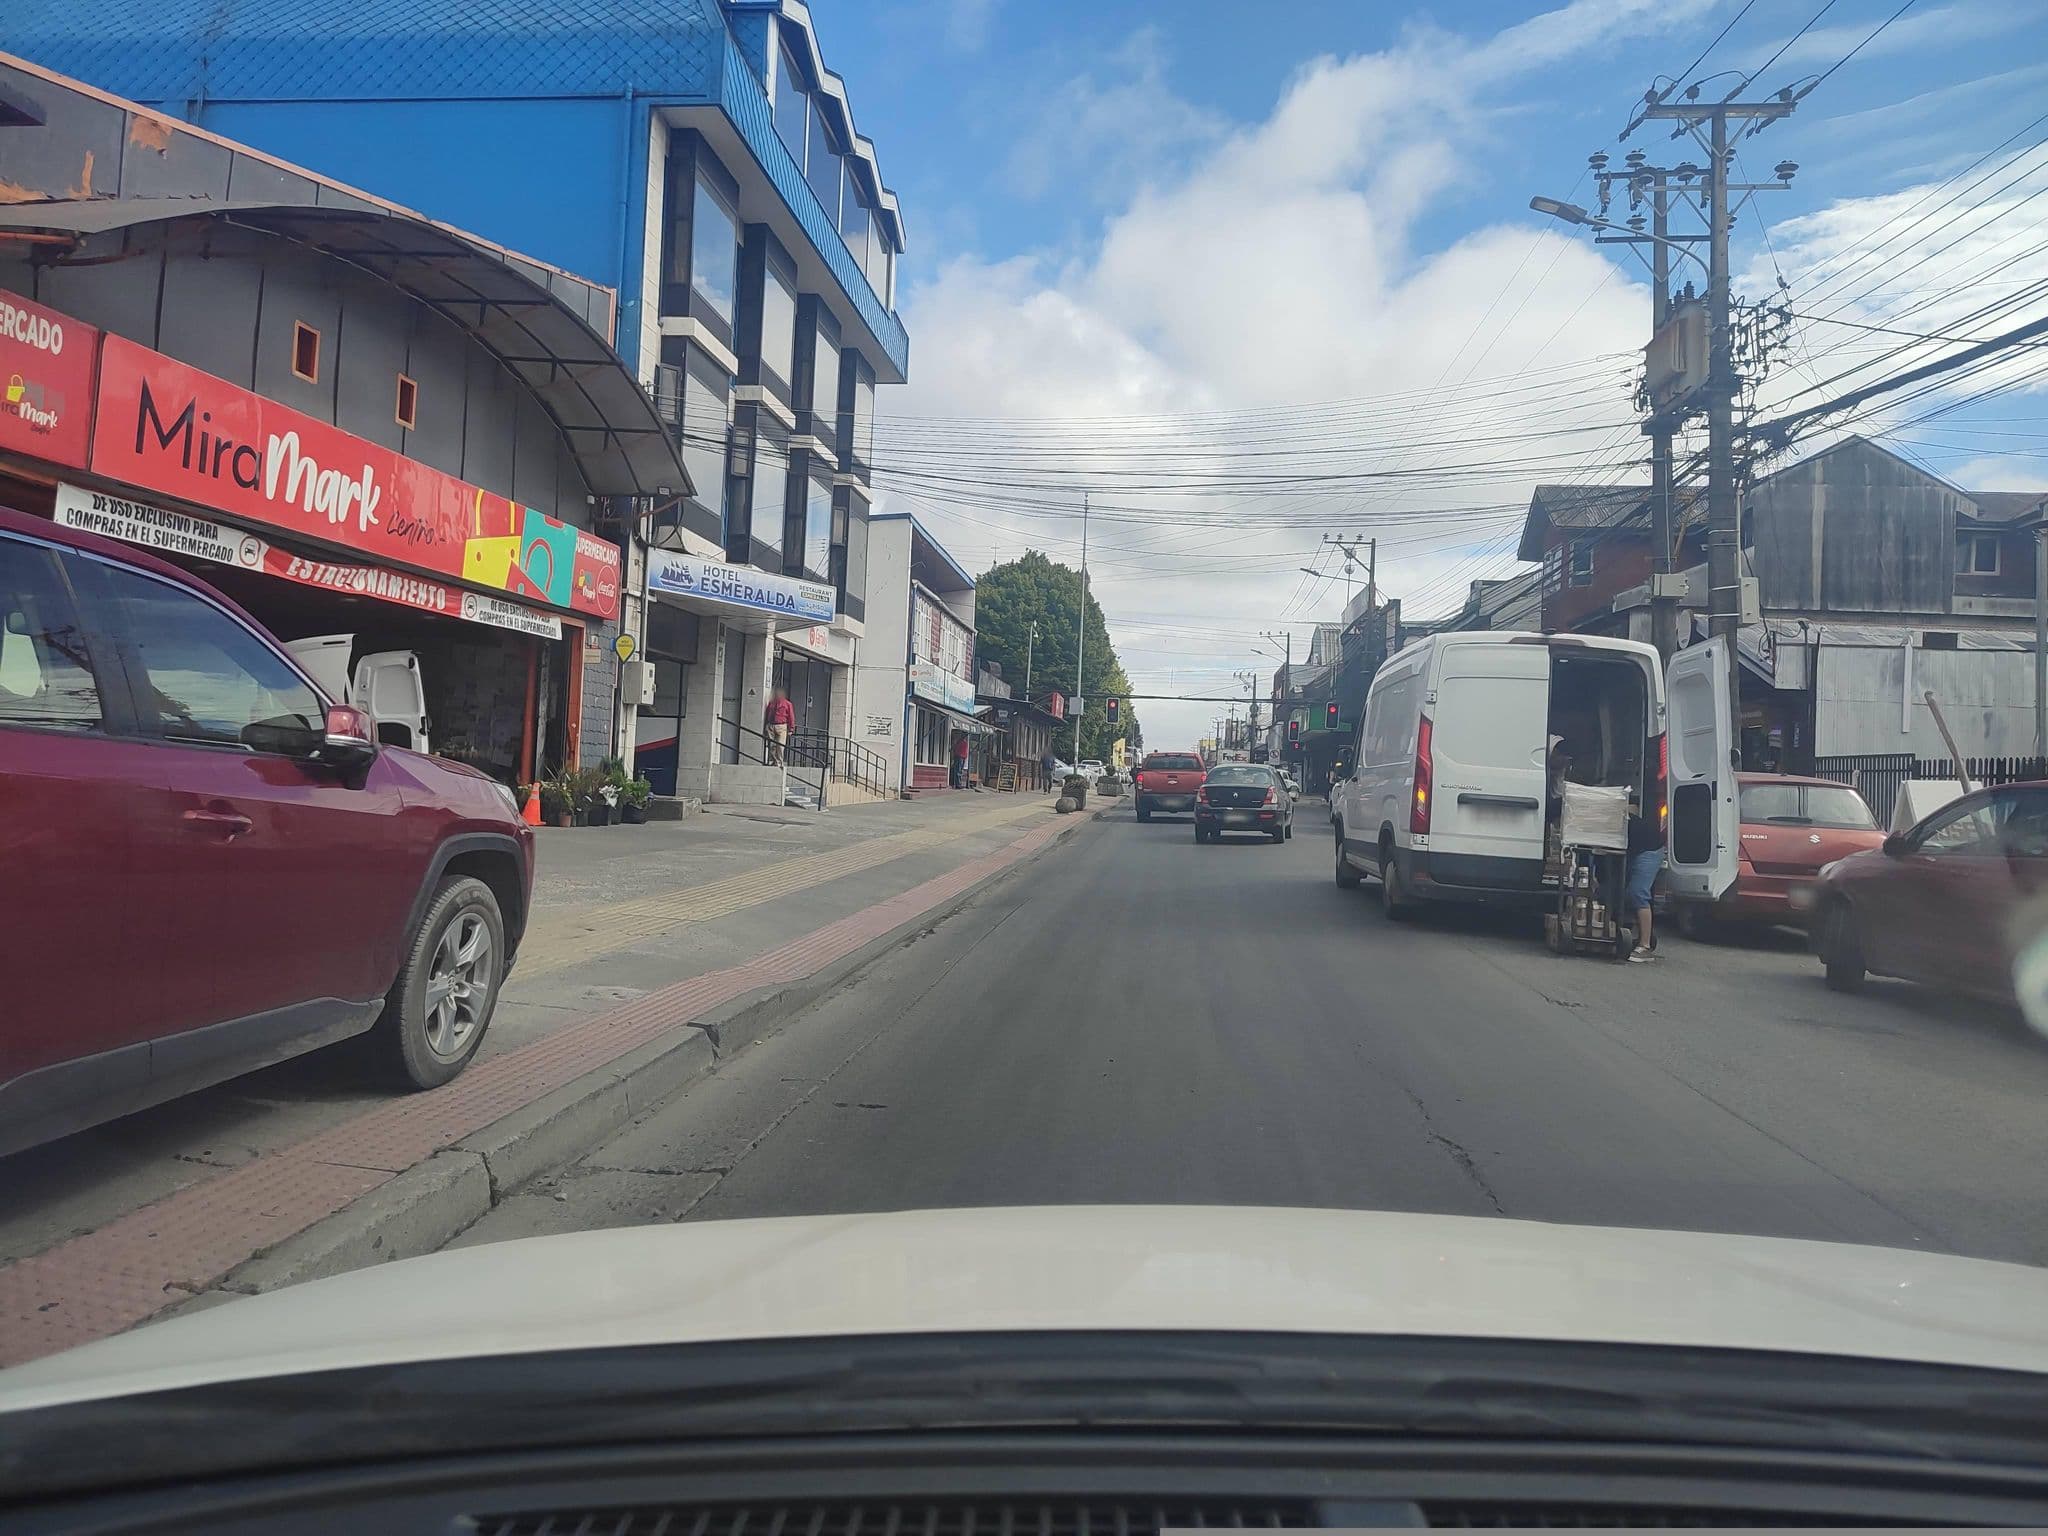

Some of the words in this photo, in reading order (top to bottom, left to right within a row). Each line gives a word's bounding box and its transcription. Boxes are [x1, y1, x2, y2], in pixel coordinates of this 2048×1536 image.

[92, 494, 107, 513] DE
[110, 498, 132, 518] USO
[134, 504, 191, 533] EXCLUSIVO
[192, 522, 218, 541] PARA
[66, 508, 122, 536] COMPRAS
[125, 522, 139, 541] EN
[141, 526, 150, 543] EL
[153, 529, 233, 562] SUPERMERCADO
[286, 557, 446, 611] ESTACIONAMIENTO
[703, 565, 741, 582] HOTEL
[700, 576, 796, 609] ESMERALDA
[799, 584, 832, 597] RESTAURANT
[479, 610, 505, 626] COMPRAS
[1222, 753, 1249, 762] FedEx
